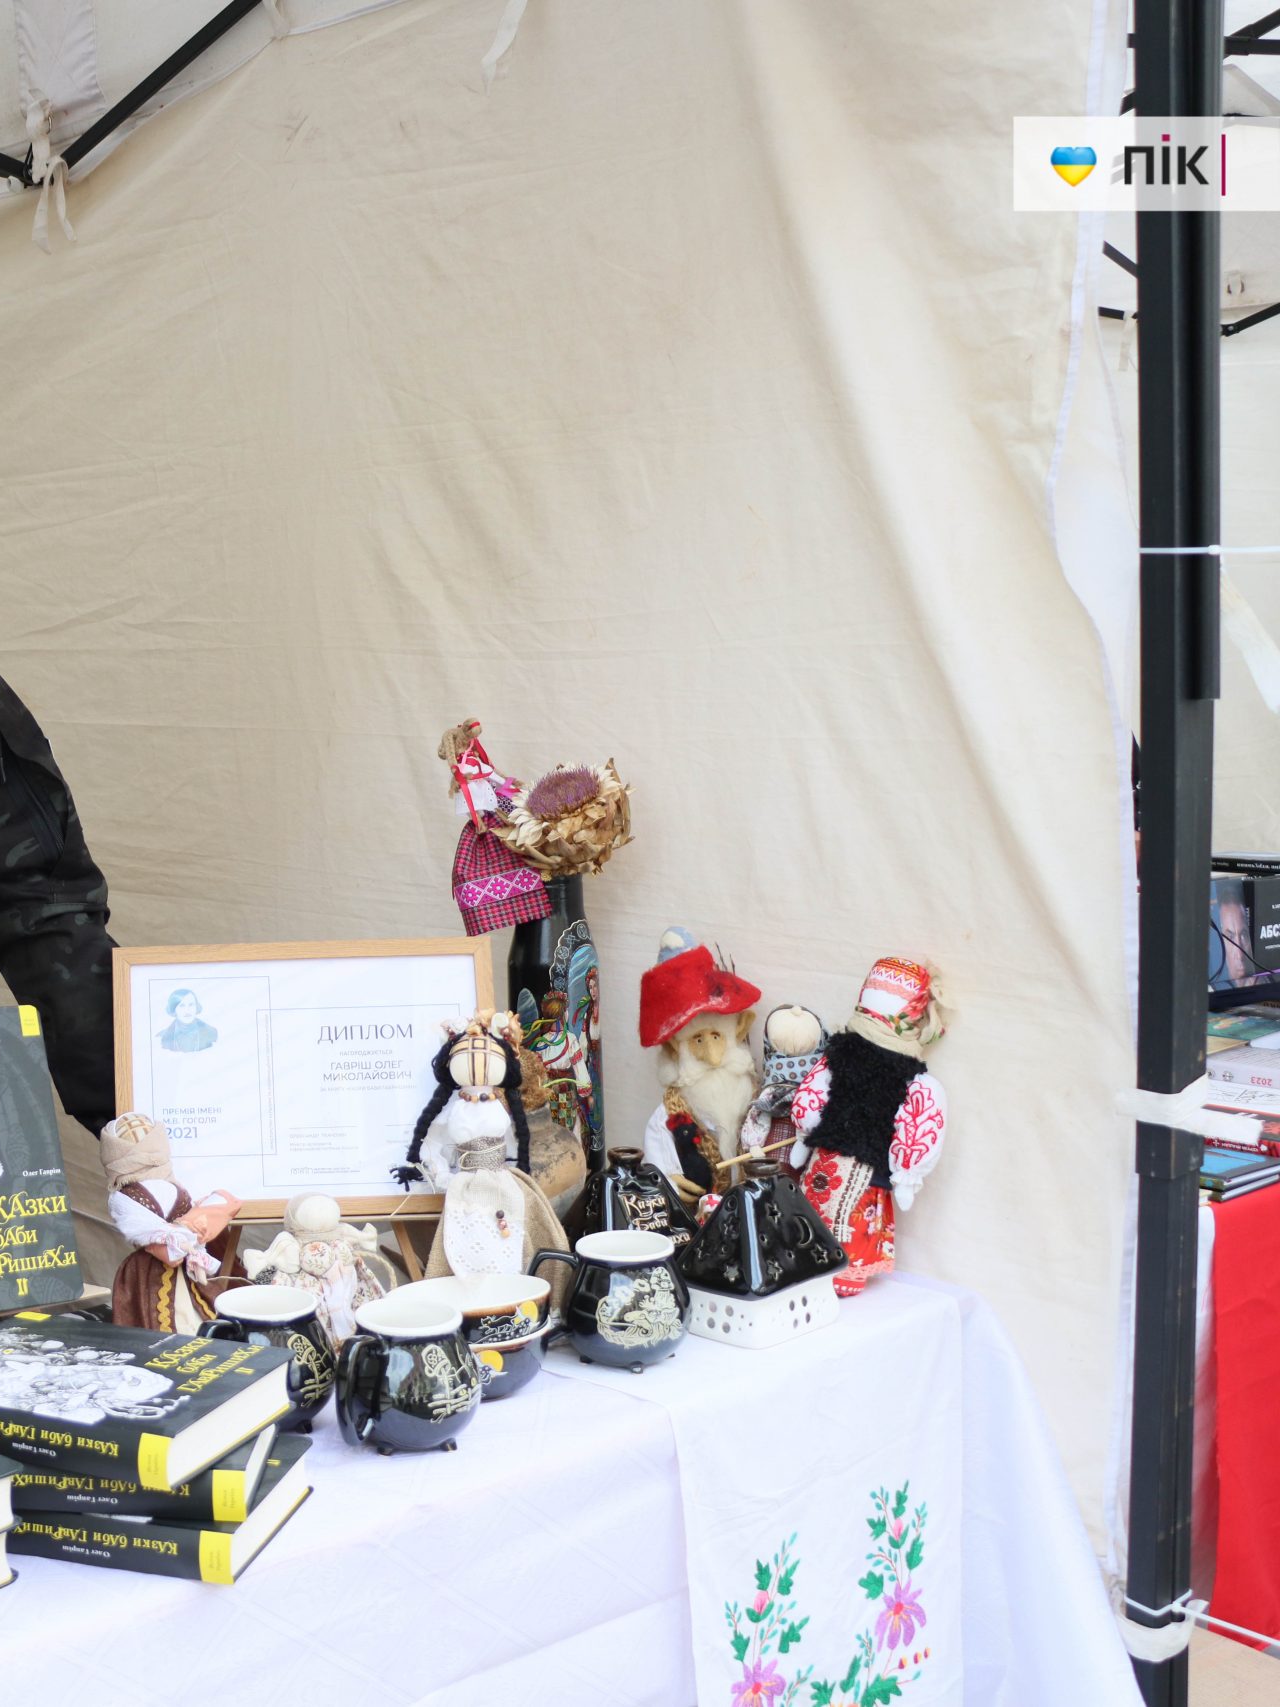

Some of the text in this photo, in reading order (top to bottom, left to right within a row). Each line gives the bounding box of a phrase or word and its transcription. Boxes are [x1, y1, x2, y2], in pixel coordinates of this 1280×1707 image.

[1260, 923, 1280, 940] АБС
[317, 1023, 413, 1045] ДИПЛОМ
[330, 1059, 403, 1071] ГАВРІШ ОЛЕГ
[323, 1070, 412, 1081] МИКОЛАЙОВИЧ
[1250, 1076, 1273, 1087] 2023
[162, 1106, 222, 1115] ПРЕМІЯ ІМЕНІ
[182, 1116, 217, 1125] ГОГОЛЯ
[165, 1126, 198, 1139] 2021
[22, 1167, 61, 1177] Олег Гавріш
[11, 1442, 57, 1457] Олег Гавріш
[66, 1494, 96, 1503] Гавріш
[61, 1545, 111, 1558] Олег Гавріш
